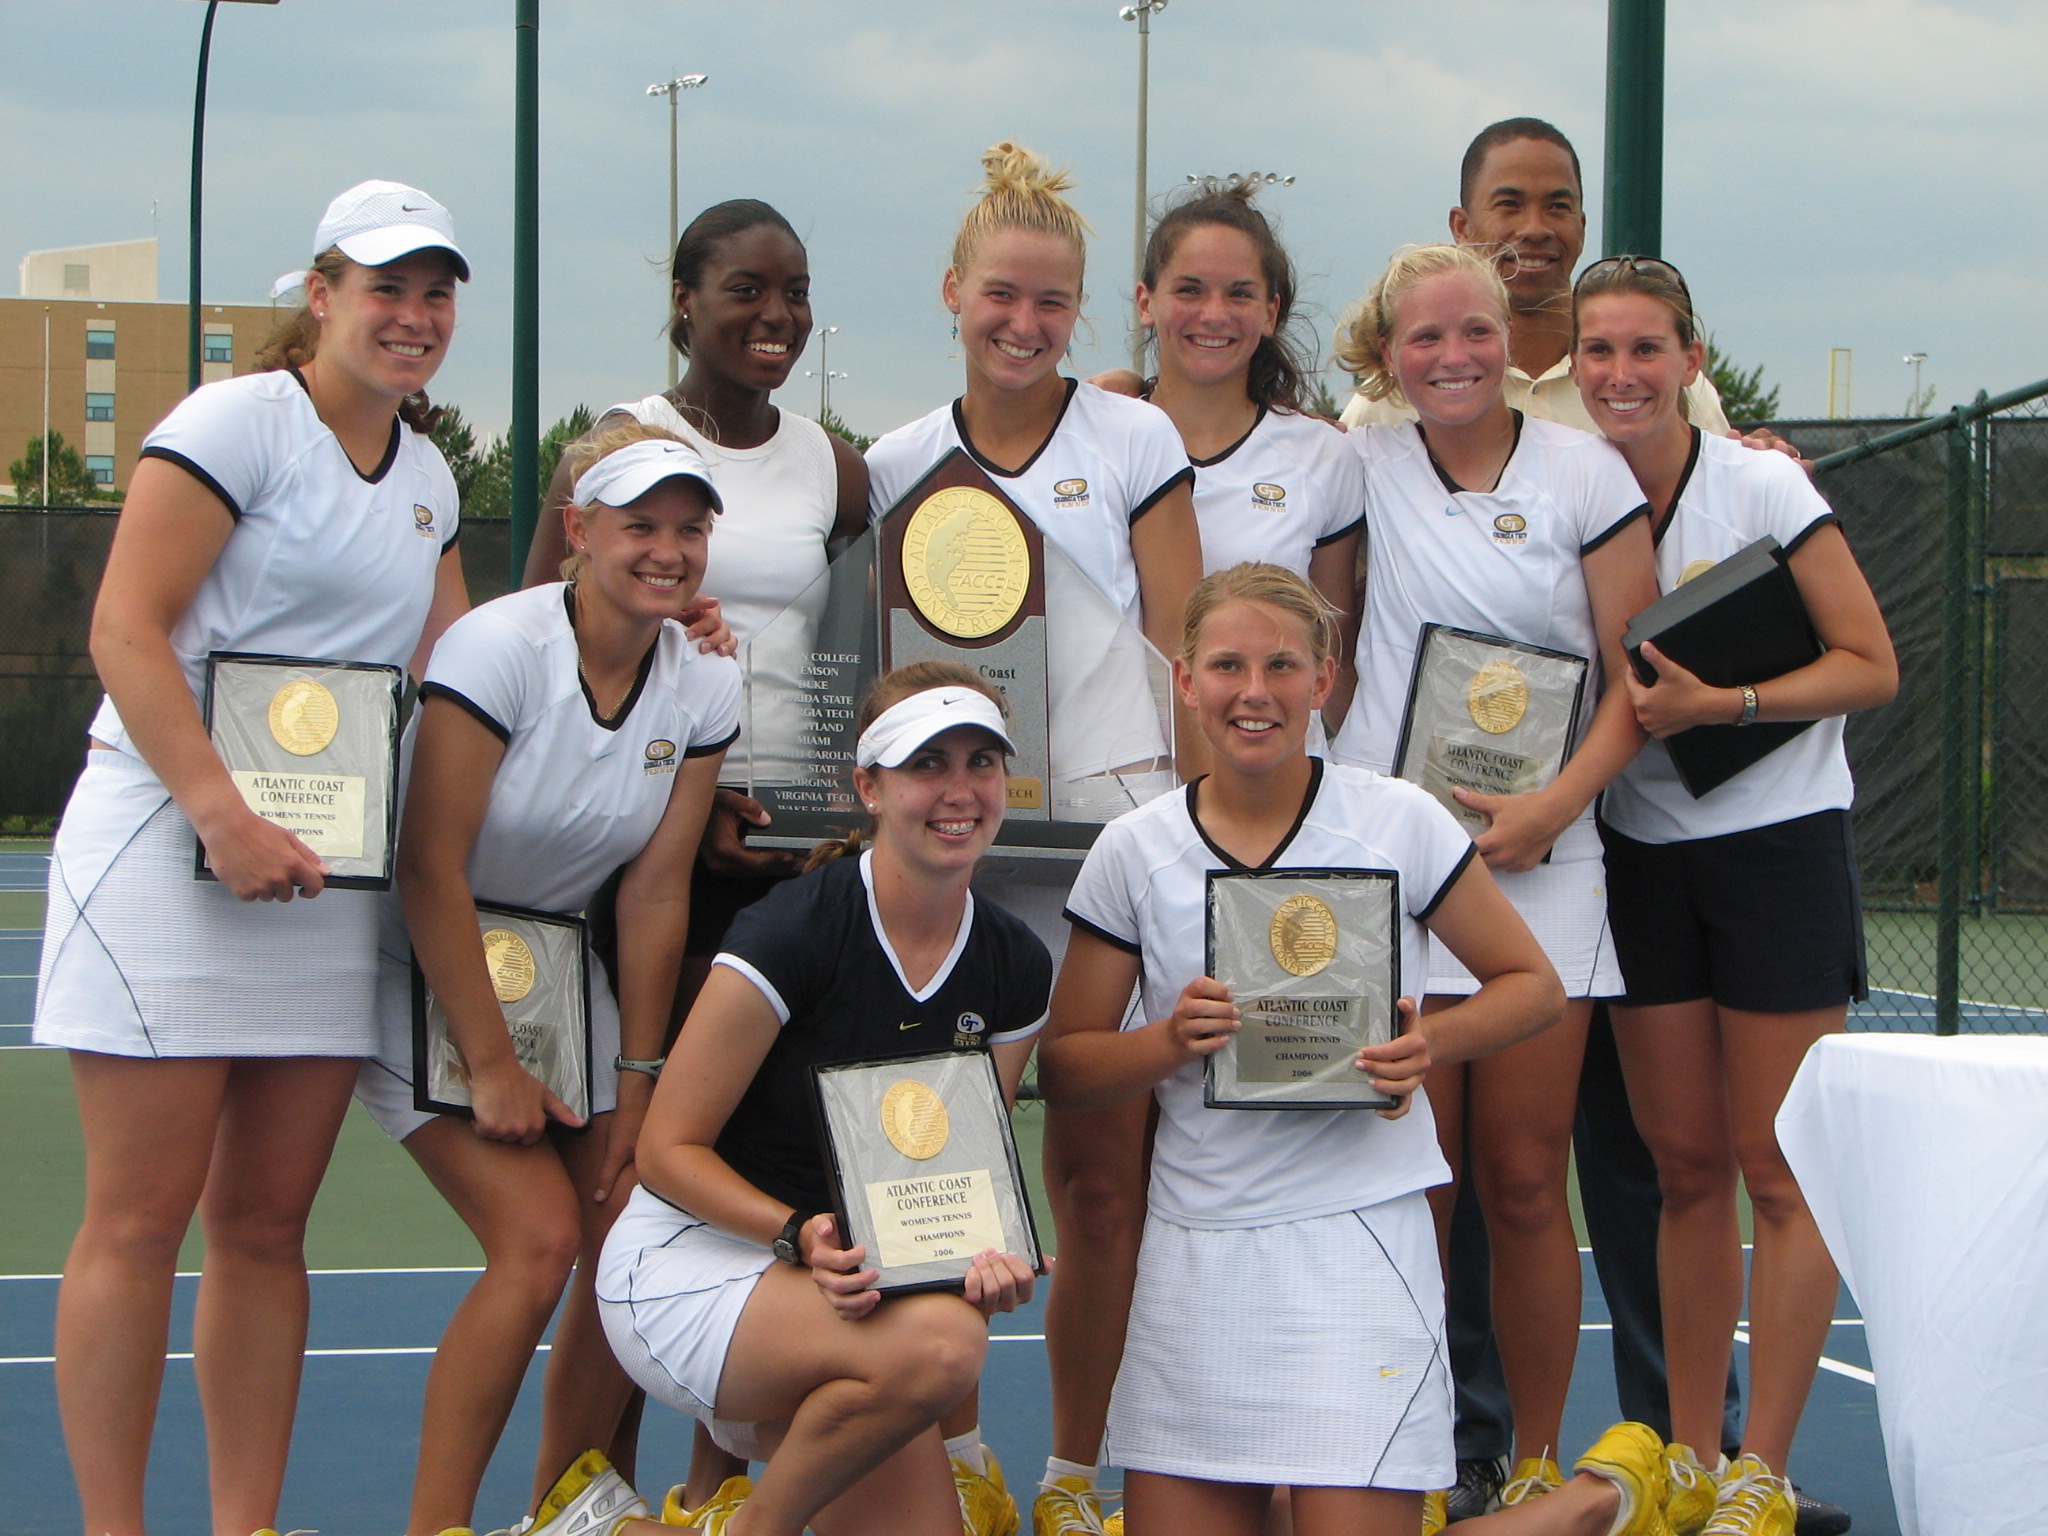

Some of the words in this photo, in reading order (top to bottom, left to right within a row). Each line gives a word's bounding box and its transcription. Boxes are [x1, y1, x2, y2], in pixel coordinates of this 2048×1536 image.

[909, 492, 982, 563] ATLANTIC
[985, 505, 1025, 568] COAST
[960, 574, 996, 588] ACC
[910, 575, 1021, 633] CONFERENCE
[811, 653, 861, 664] COLLEGE
[801, 666, 839, 676] EMSON
[980, 664, 1016, 679] Coast
[799, 680, 828, 690] DUKE
[823, 695, 853, 705] STATE
[825, 709, 854, 719] TECH
[798, 736, 830, 745] MIAMI
[1448, 744, 1490, 763] ATLANTIC
[1494, 755, 1524, 770] COAST
[808, 764, 839, 774] STATE
[1450, 758, 1514, 781] CONFERENCE
[252, 777, 305, 790] ATLANTIC
[310, 780, 345, 792] COAST
[791, 779, 838, 788] VIRGINIA
[261, 791, 335, 805] CONFERENCE
[775, 790, 823, 802] VIRGINIA
[826, 793, 855, 802] TECH
[1008, 789, 1033, 798] ECH
[259, 811, 301, 819] WOMEN'S
[304, 812, 336, 820] TENNIS
[1256, 1000, 1308, 1012] ATLANTIC
[1314, 1000, 1348, 1012] COAST
[1265, 1015, 1339, 1027] CONFERENCE
[1276, 1053, 1329, 1061] CHAMPIONS
[886, 1180, 936, 1198] ATLANTIC
[939, 1176, 972, 1190] COAST
[897, 1192, 967, 1210] CONFERENCE
[900, 1216, 940, 1227] WOMEN'S
[941, 1212, 972, 1223] TENNIS
[914, 1230, 965, 1242] CHAMPIONS
[933, 1249, 954, 1257] 2006
